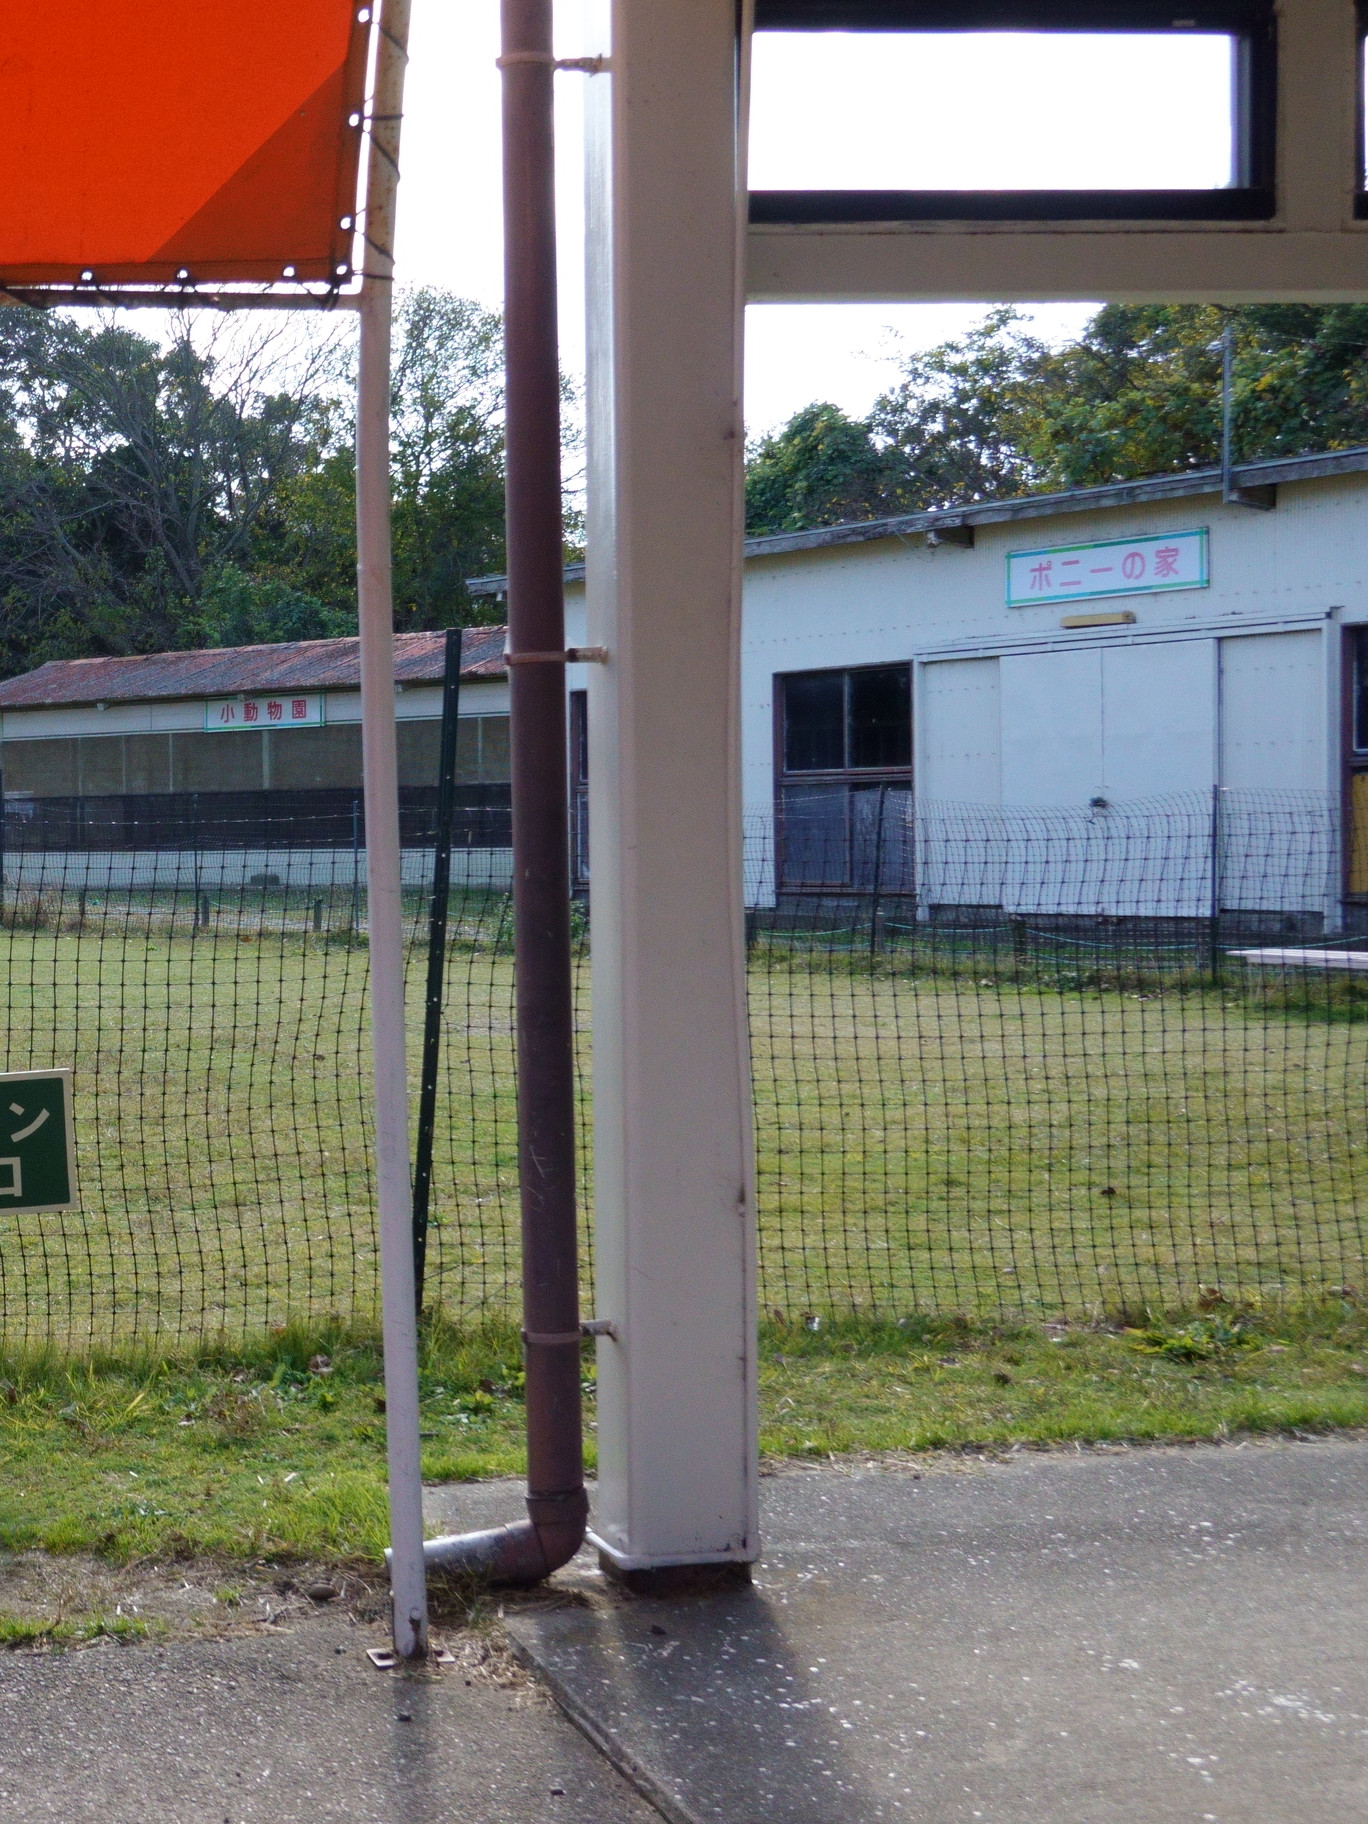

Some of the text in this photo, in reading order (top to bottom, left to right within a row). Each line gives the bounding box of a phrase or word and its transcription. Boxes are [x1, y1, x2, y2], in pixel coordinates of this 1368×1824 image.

[1029, 546, 1180, 591] ポニーの家
[220, 699, 307, 723] 小動物園
